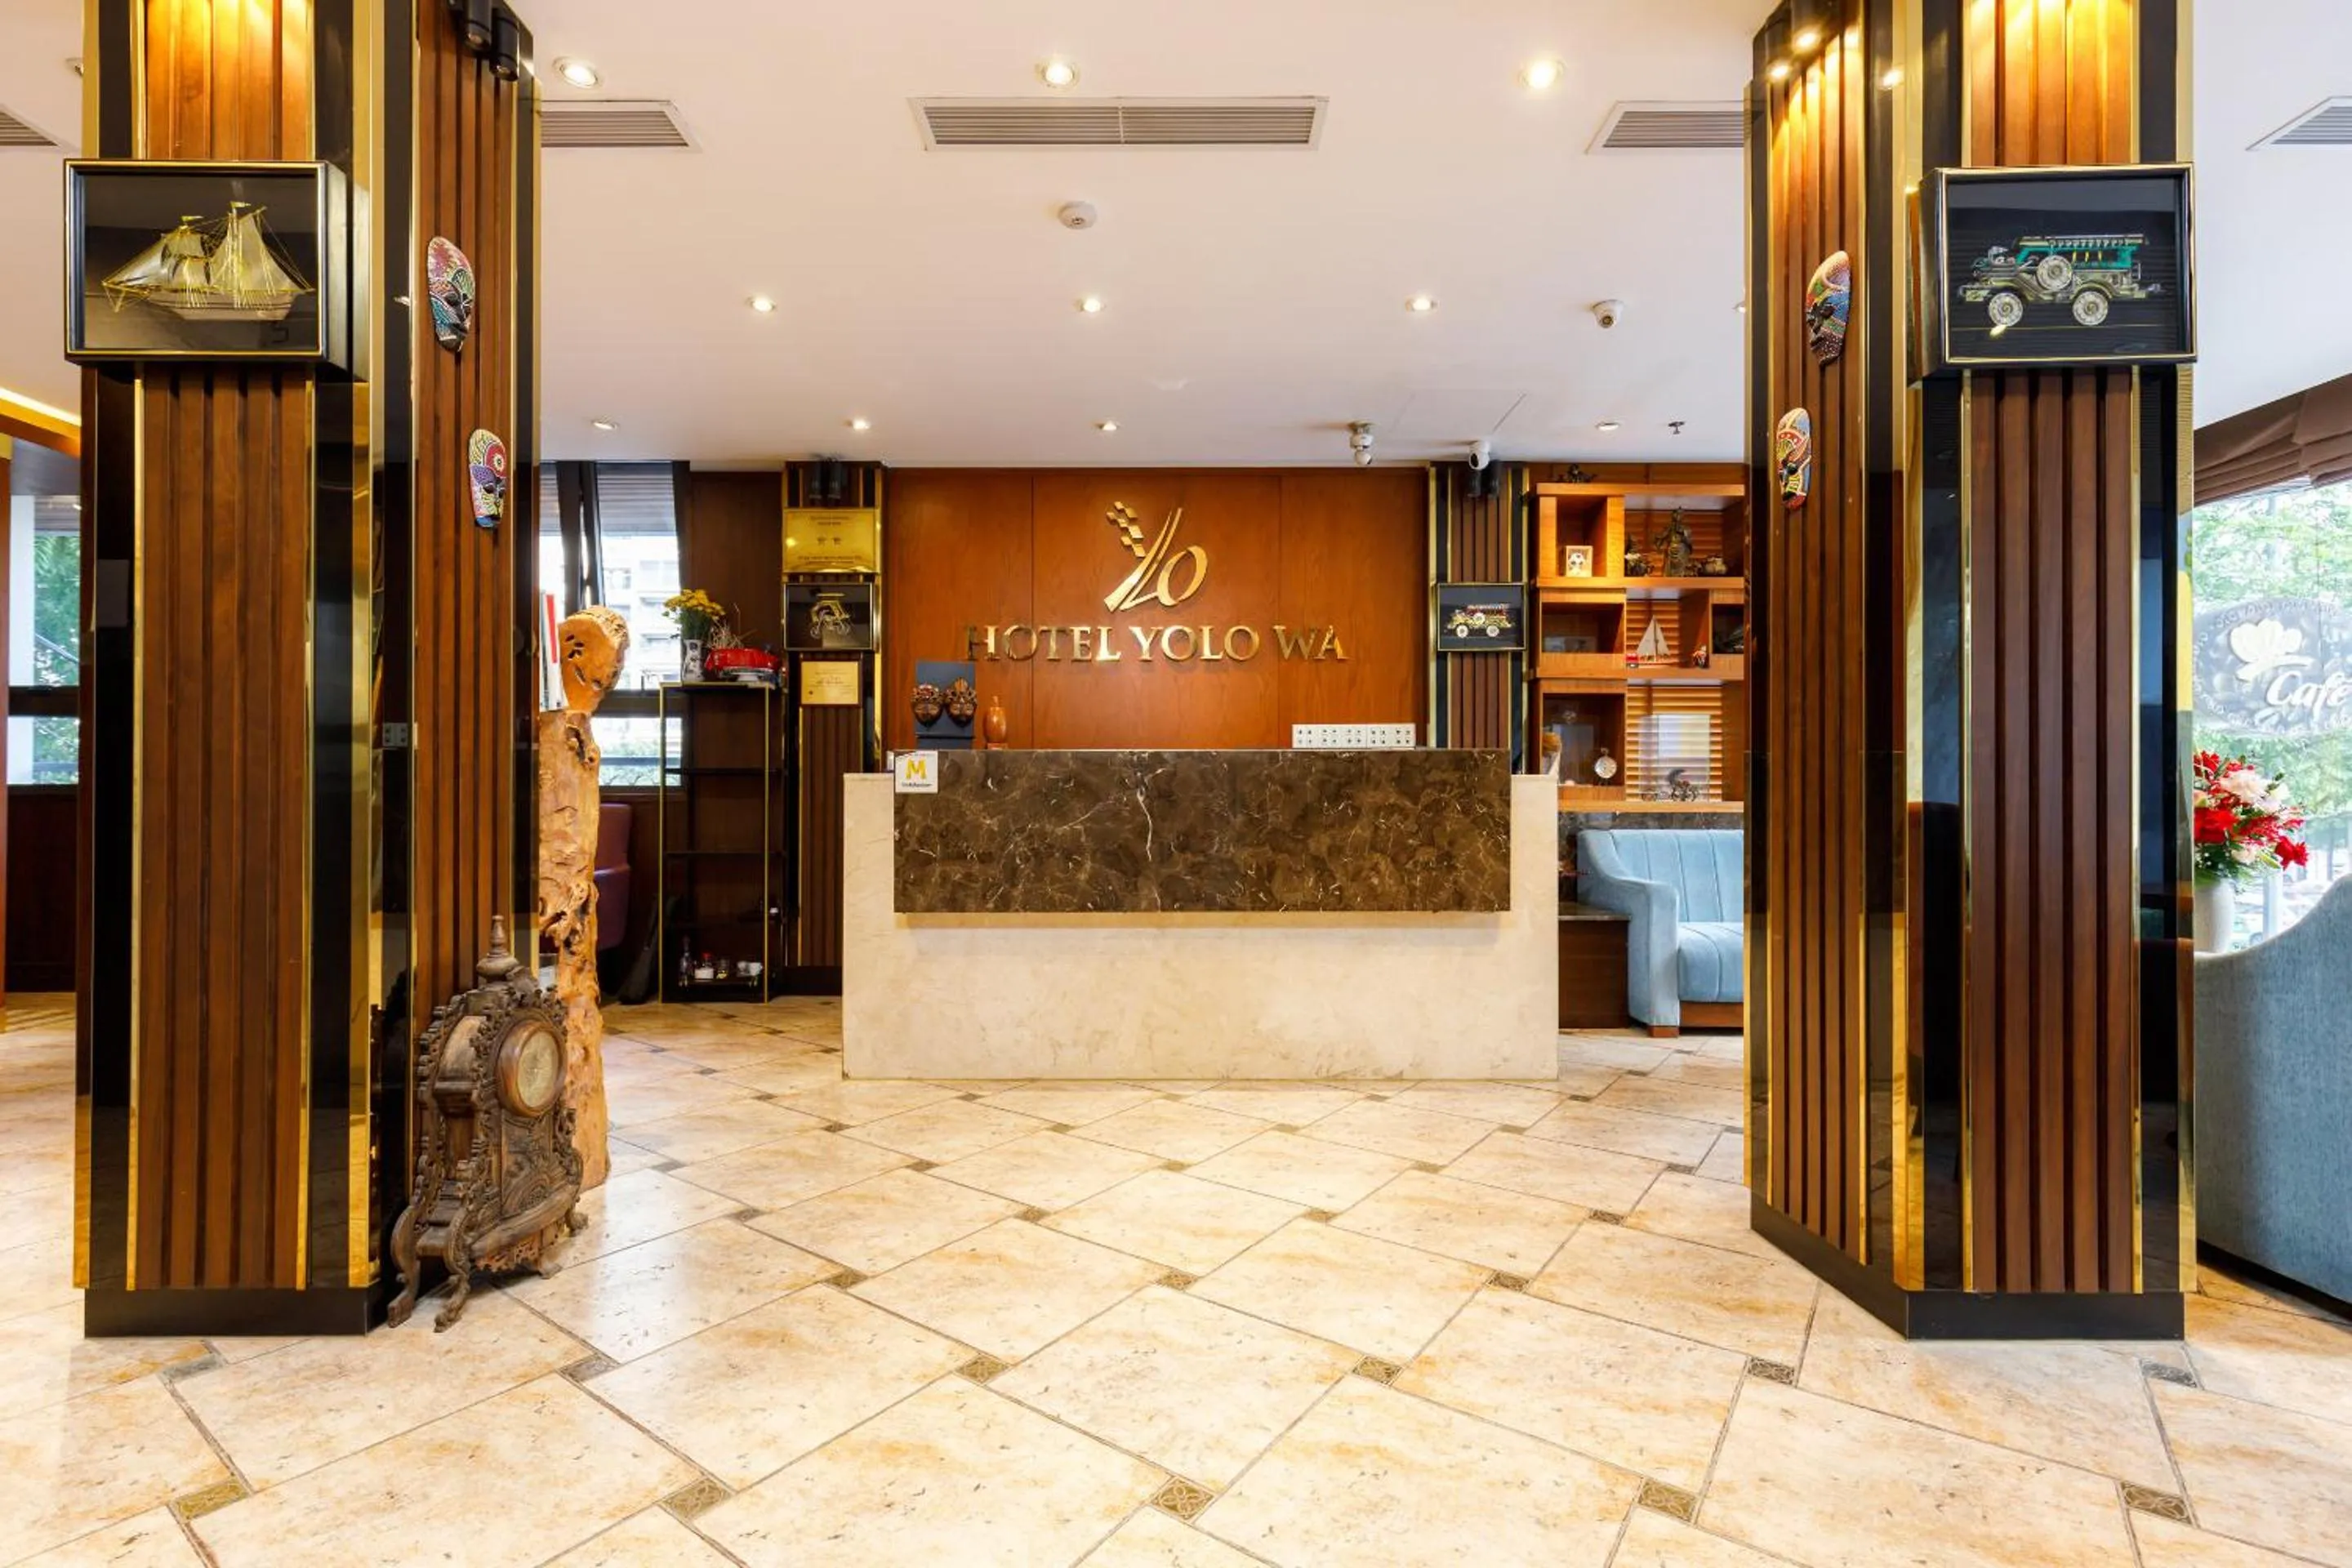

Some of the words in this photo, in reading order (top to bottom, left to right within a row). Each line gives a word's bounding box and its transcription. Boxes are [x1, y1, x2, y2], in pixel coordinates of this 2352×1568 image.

[964, 624, 1122, 662] HOTEL
[1128, 624, 1261, 662] YOLO
[1272, 624, 1349, 662] WA
